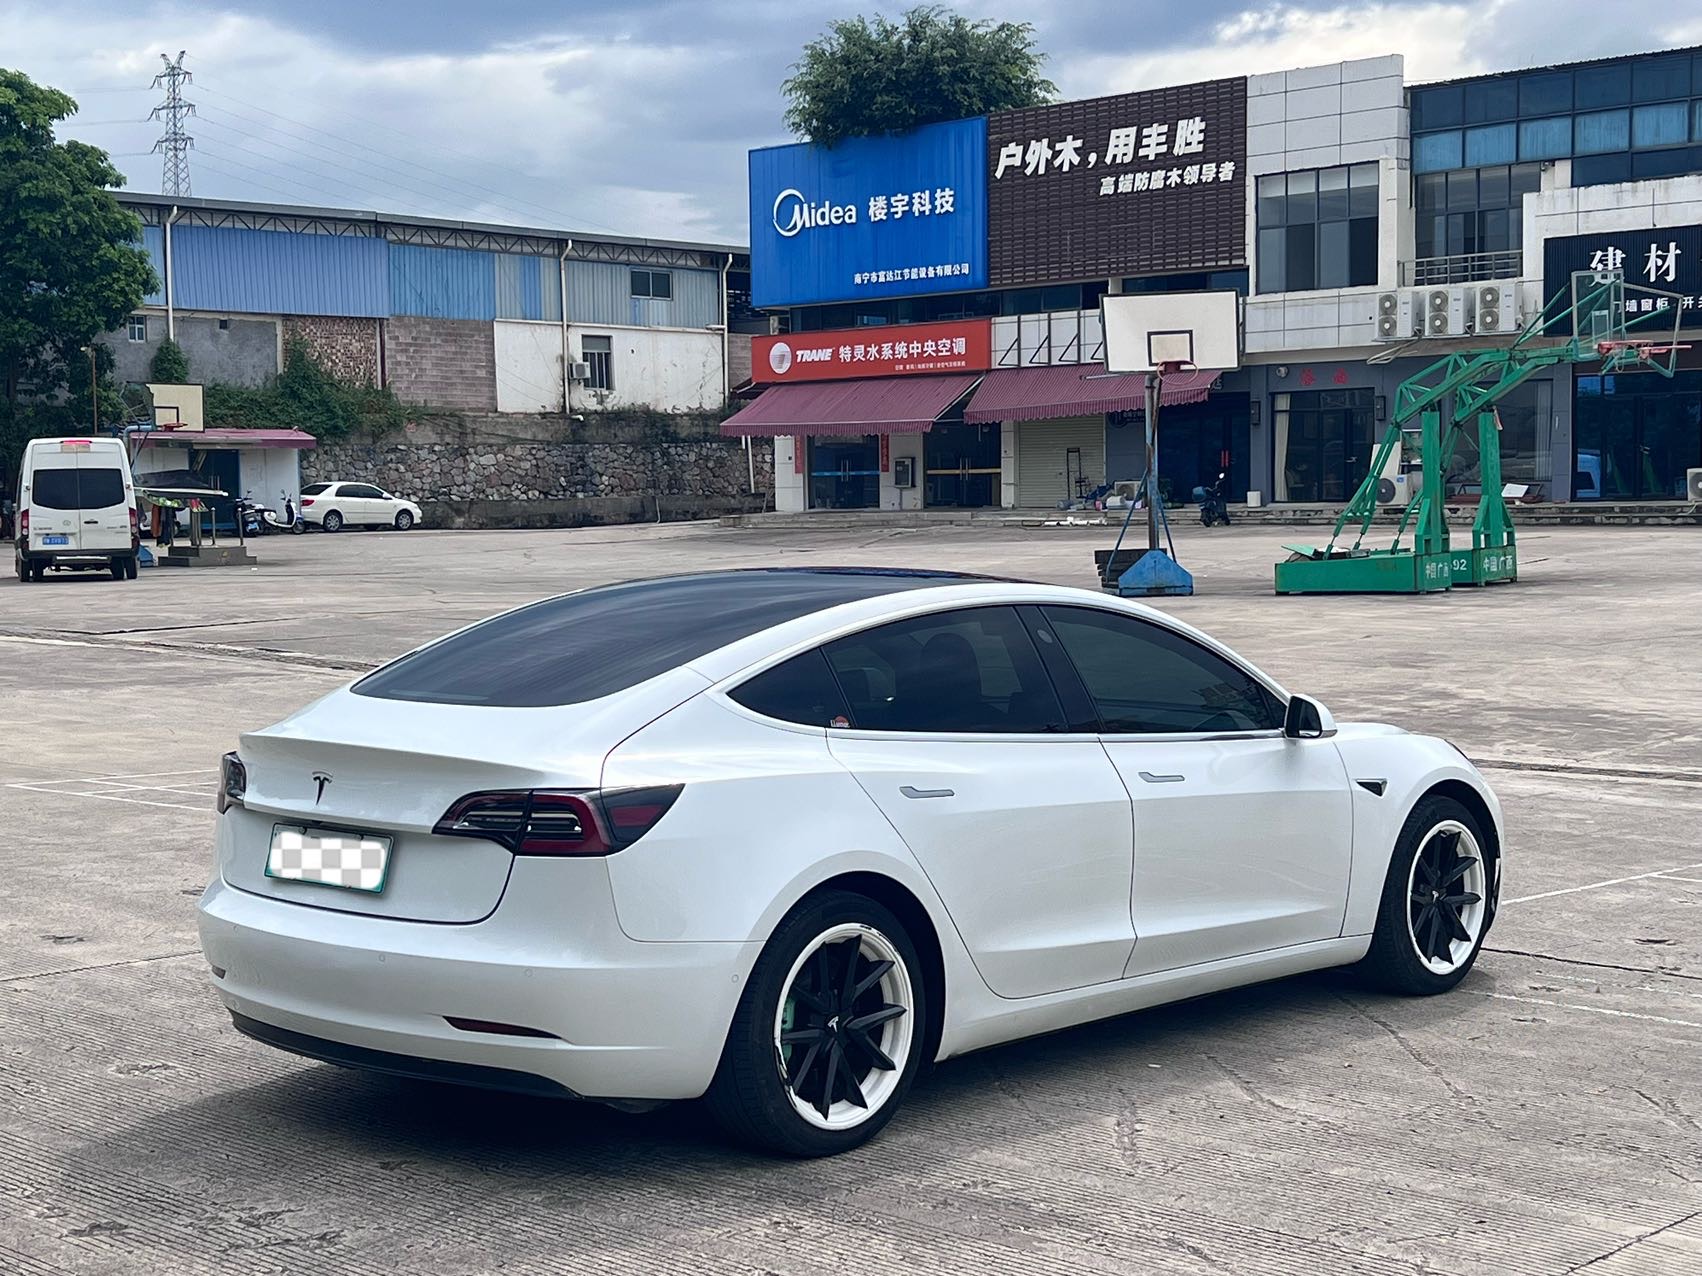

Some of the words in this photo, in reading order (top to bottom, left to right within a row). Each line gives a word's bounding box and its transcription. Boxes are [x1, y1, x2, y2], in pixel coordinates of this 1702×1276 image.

[1100, 161, 1236, 196] 高端防腐木领导者
[773, 188, 857, 236] Midea
[868, 187, 955, 222] 楼宇科技
[796, 348, 833, 362] TRANE
[838, 337, 966, 362] 特灵水系统中央空调
[1450, 559, 1467, 571] 92
